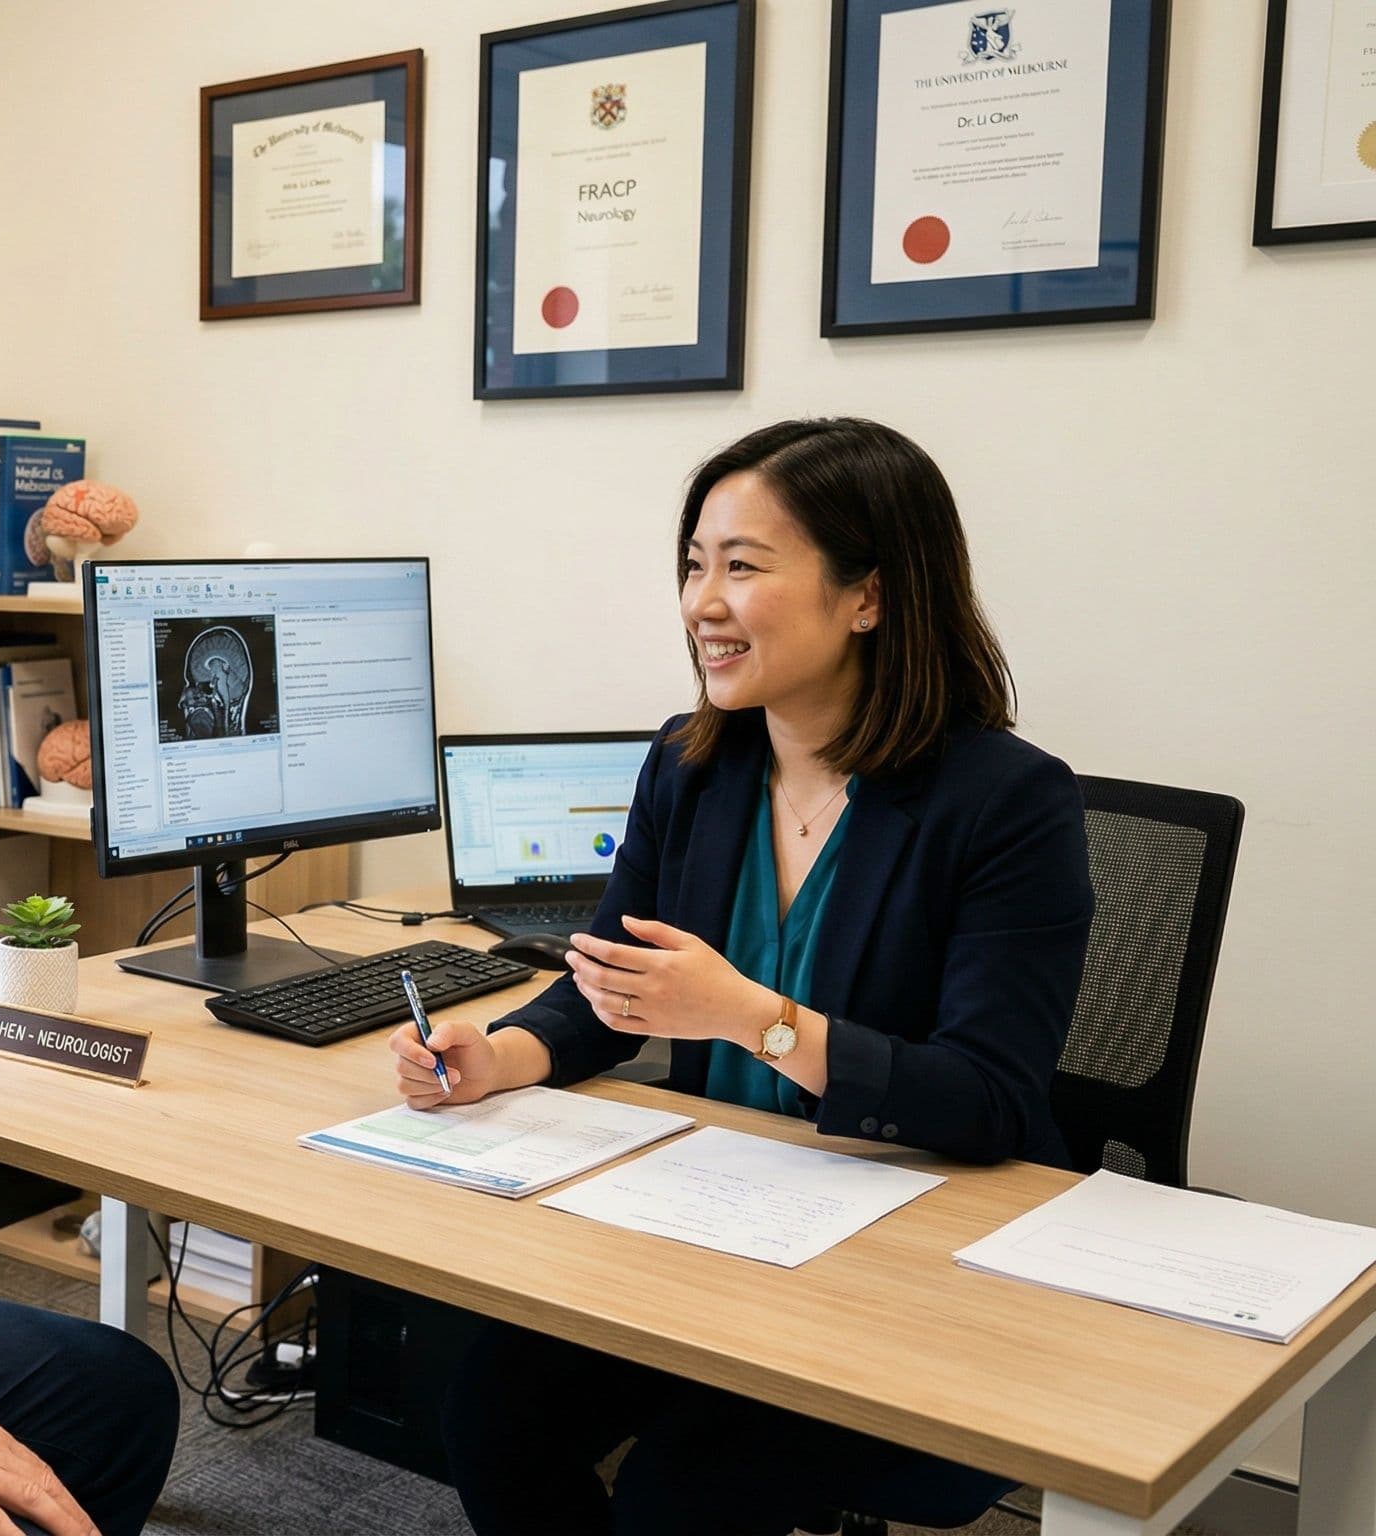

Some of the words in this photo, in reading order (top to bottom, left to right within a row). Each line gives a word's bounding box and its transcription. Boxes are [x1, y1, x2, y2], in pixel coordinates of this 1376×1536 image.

[914, 79, 933, 89] THE
[935, 70, 989, 87] UNIVERSITY
[992, 68, 1005, 78] OF
[1008, 59, 1069, 76] MELBOURNE
[957, 116, 975, 128] Dr.
[977, 114, 986, 126] Li
[990, 112, 1019, 124] Chen
[578, 179, 637, 202] FRACP
[577, 207, 637, 224] Neurology
[37, 1029, 132, 1064] NEUROLOGIST
